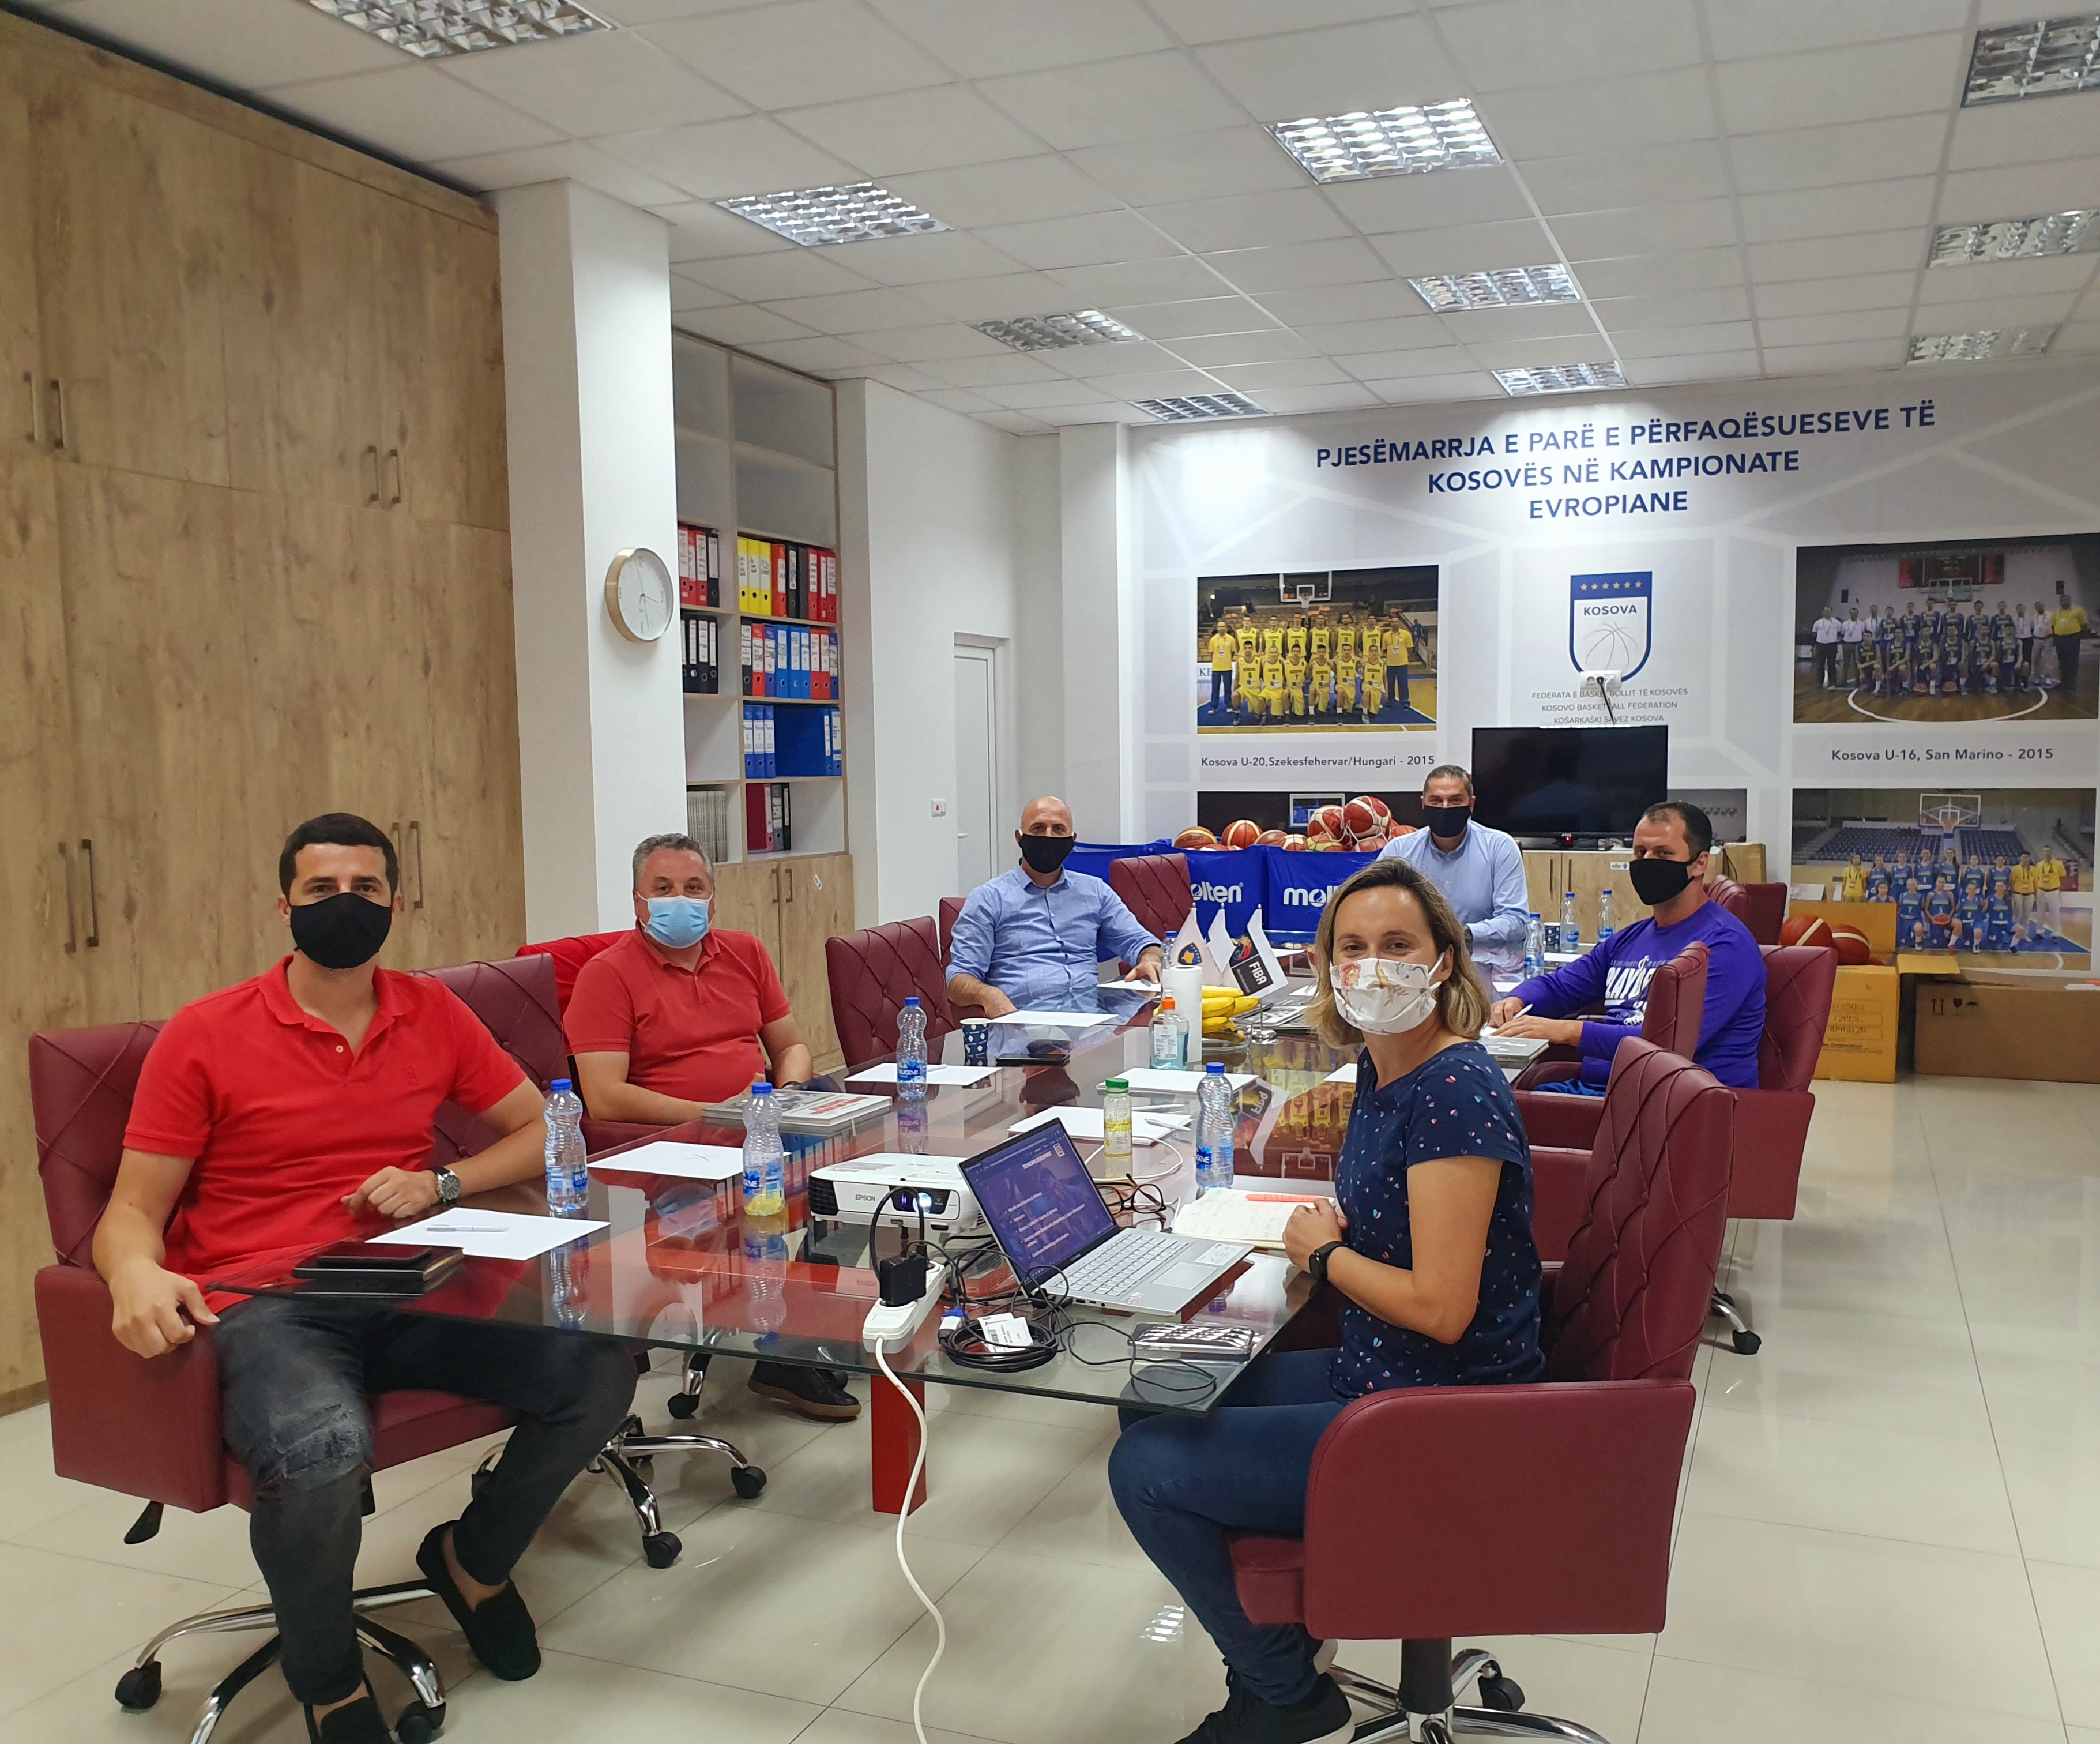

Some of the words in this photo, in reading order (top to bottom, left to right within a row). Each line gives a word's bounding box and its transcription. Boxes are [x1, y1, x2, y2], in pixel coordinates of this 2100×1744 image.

[1316, 436, 1495, 468] PJESËMARRJA
[1505, 434, 1518, 453] E
[1529, 423, 1594, 452] PARË
[1606, 427, 1620, 446] E
[1631, 408, 1890, 445] PËRFAQËSUESEVE
[1899, 399, 1935, 428] TË
[1429, 462, 1553, 493] KOSOVËS
[1564, 458, 1599, 484] NË
[1610, 450, 1800, 481] KAMPIONATE
[1530, 491, 1688, 519] EVROPIANE
[1583, 604, 1638, 616] KOSOVA
[1532, 691, 1571, 699] FEDERATA
[1650, 687, 1688, 696] KOSOVËS
[1542, 704, 1575, 712] KOSOVO
[1577, 702, 1626, 711] BASKETALL
[1628, 701, 1677, 709] FEDERATION
[1554, 715, 1602, 724] KOŠARKAŠKI
[1201, 757, 1238, 766] Kosova
[1407, 755, 1435, 765] 2015
[1832, 749, 1880, 760] Kosova
[1885, 749, 1921, 761] U-16,
[1925, 749, 1950, 760] San
[1955, 748, 2004, 760] Marino
[2018, 748, 2053, 760] 2015
[1190, 881, 1243, 903] olten
[1248, 961, 1267, 986] FIBA
